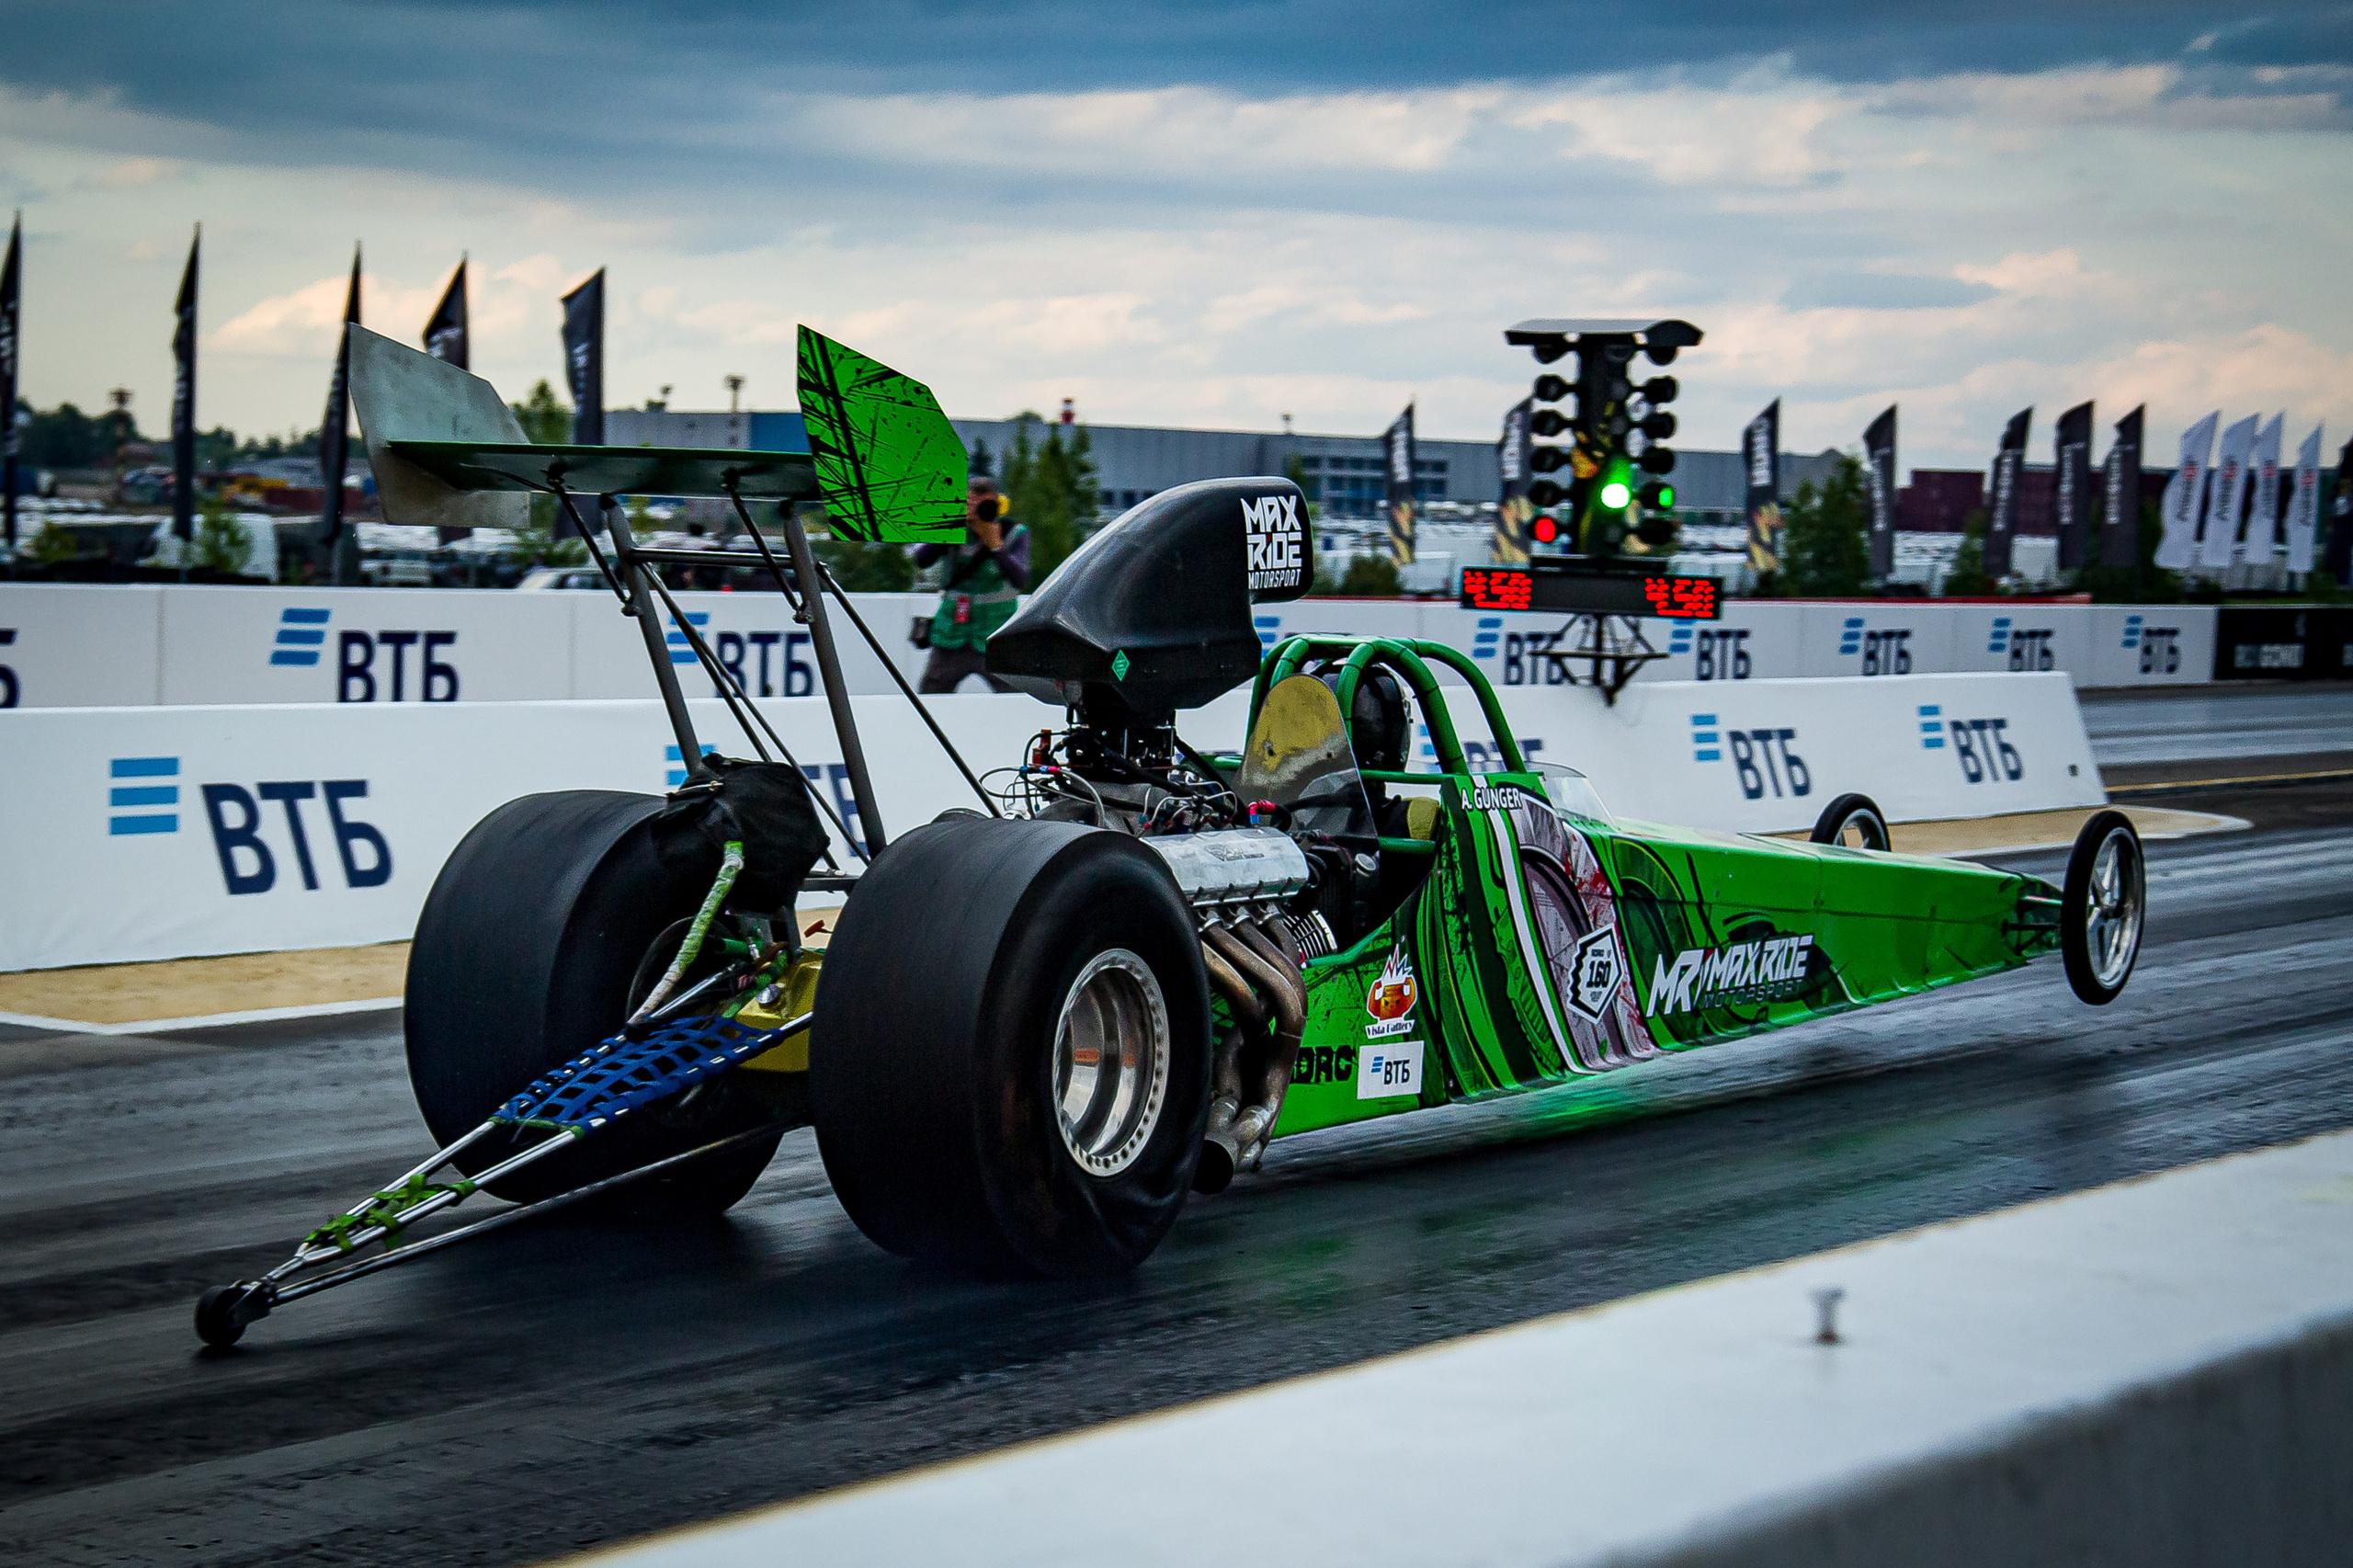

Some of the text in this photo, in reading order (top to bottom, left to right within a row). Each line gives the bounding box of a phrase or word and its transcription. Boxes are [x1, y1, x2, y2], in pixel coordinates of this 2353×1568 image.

[1240, 495, 1302, 533] MAX
[1246, 531, 1302, 570] RIDE
[1248, 569, 1302, 589] MOTORSPORT
[337, 630, 460, 702] ВТБ
[716, 631, 814, 697] ВТБ
[1697, 629, 1752, 680] ВТБ
[1862, 629, 1912, 676] ВТБ
[2008, 629, 2055, 671] ВТБ
[2139, 627, 2181, 674] ВТБ
[1728, 729, 1811, 800] ВТБ
[1949, 719, 2023, 783] ВТБ
[1461, 787, 1523, 810] A. GUNGER
[200, 779, 393, 896] ВТБ
[1586, 960, 1612, 989] 160
[1702, 979, 1803, 1009] MOTORSPORT
[1383, 1059, 1411, 1085] ВТБ
